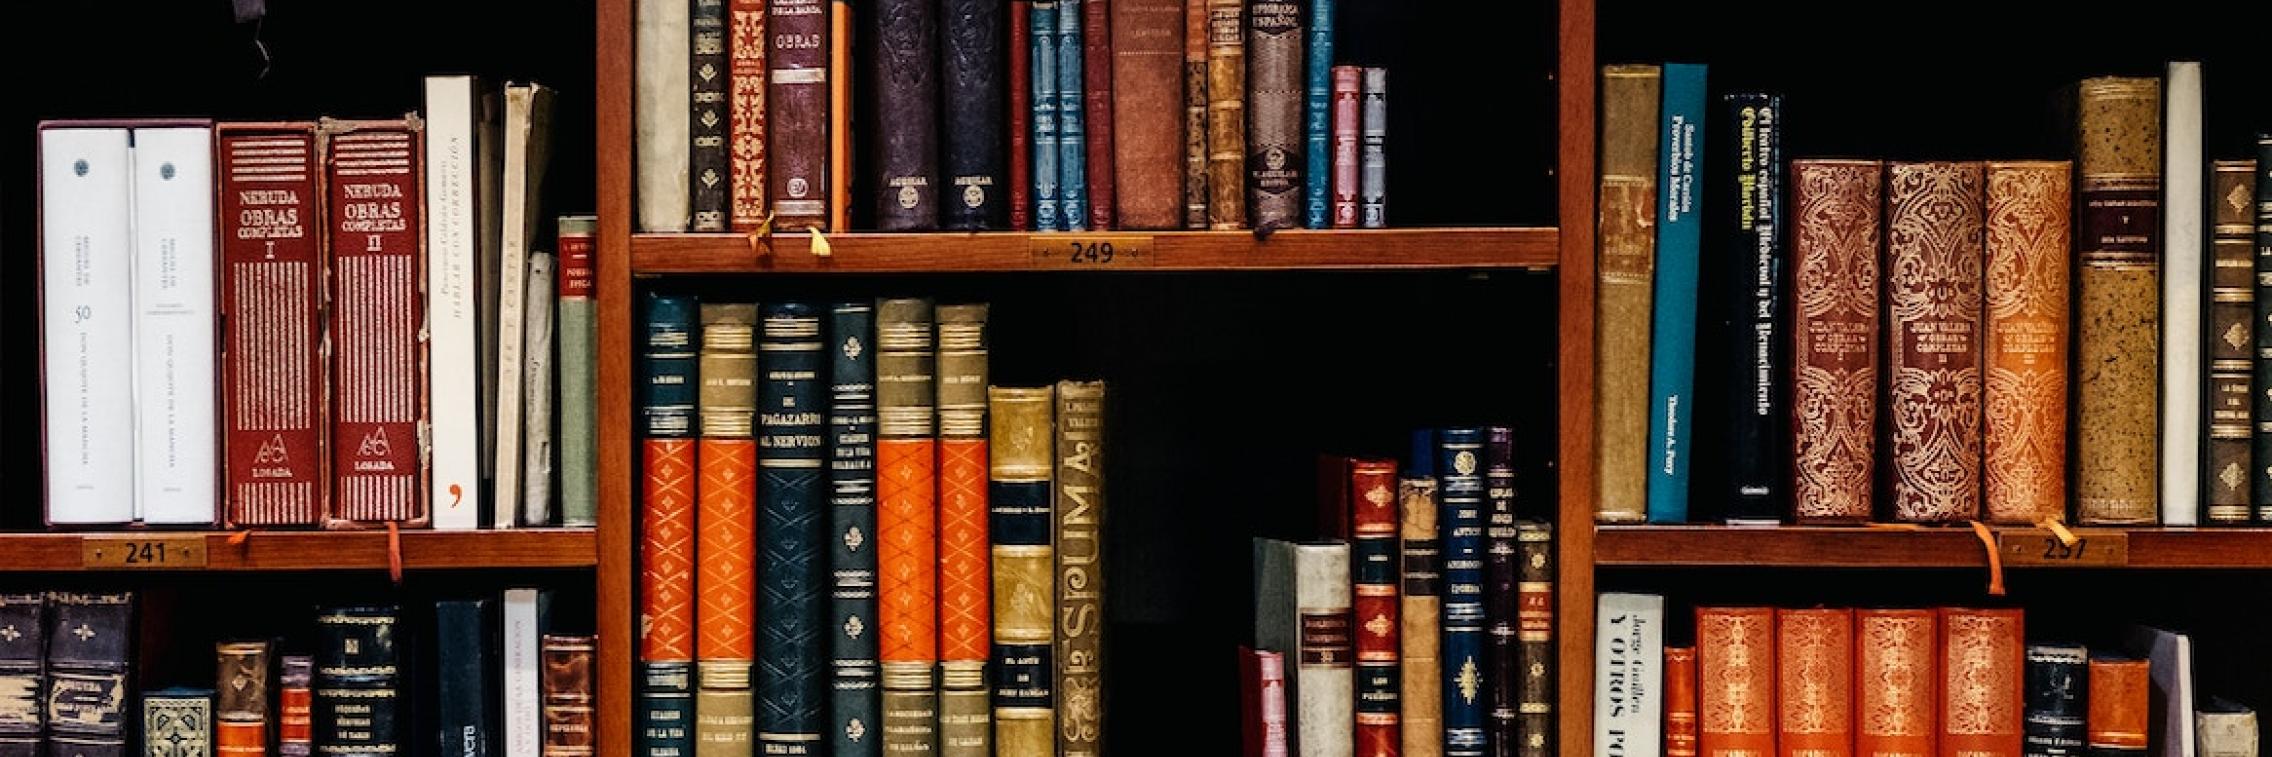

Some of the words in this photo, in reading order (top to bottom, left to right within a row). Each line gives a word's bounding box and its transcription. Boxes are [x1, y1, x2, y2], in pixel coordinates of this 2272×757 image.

[1252, 14, 1298, 28] ESPAÑOL
[775, 34, 820, 49] OBRAS
[240, 190, 299, 205] NERUDA
[342, 183, 403, 199] NERUDA
[240, 209, 297, 226] OBRAS
[345, 202, 402, 219] OBRAS
[238, 225, 303, 239] COMPLETAS
[341, 218, 406, 232] COMPLETAS
[265, 241, 275, 259] I
[367, 235, 383, 251] II
[1071, 242, 1114, 263] 249
[761, 413, 822, 425] PAGAZARRI
[125, 542, 166, 564] 241
[1609, 637, 1626, 718] OTROS
